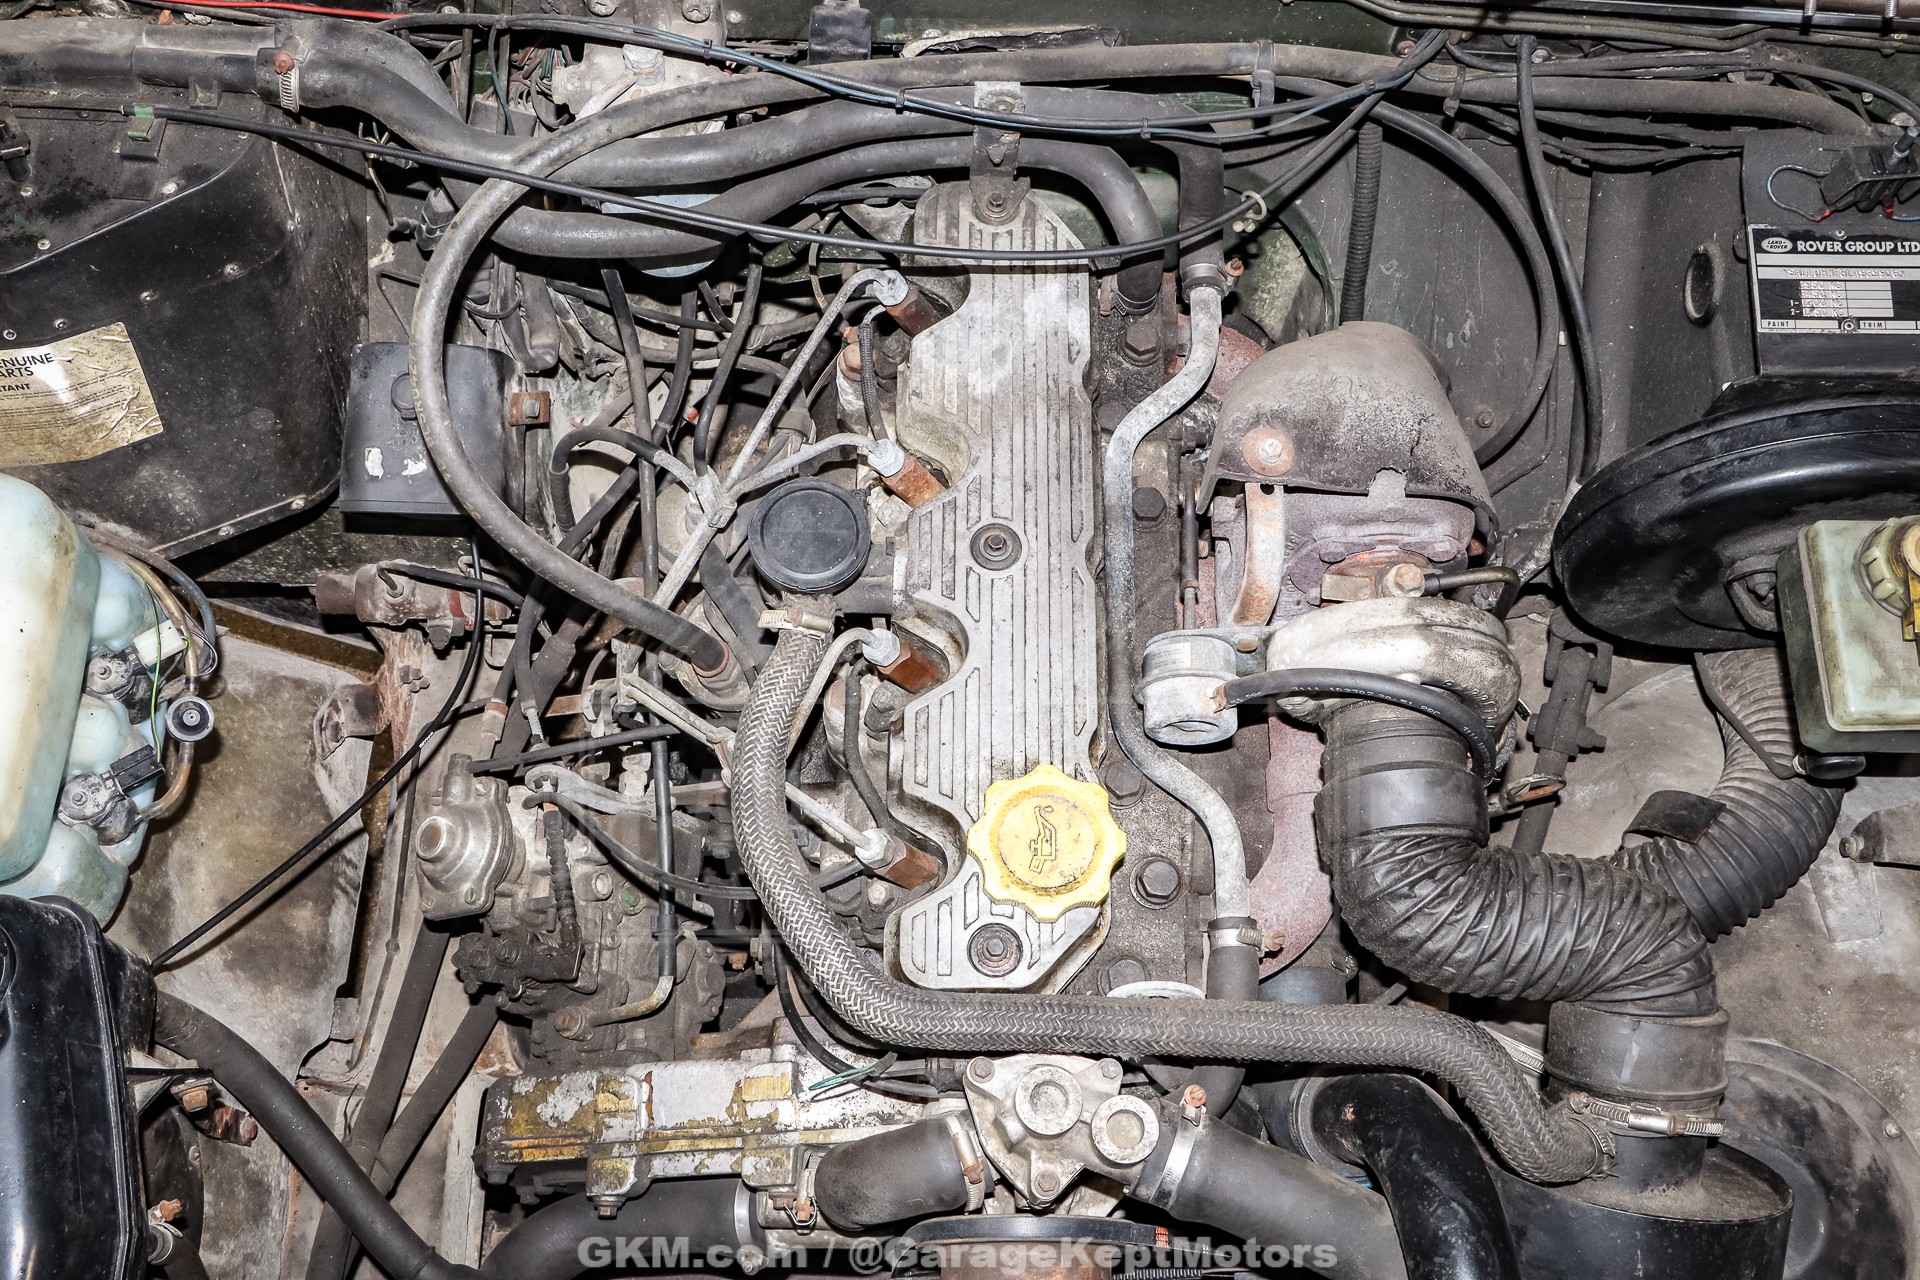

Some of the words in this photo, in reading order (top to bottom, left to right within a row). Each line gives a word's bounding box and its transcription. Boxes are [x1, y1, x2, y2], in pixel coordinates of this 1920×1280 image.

[1797, 241, 1842, 252] ROVER
[1845, 241, 1895, 253] GROUP
[1898, 242, 1920, 253] LTD
[0, 383, 30, 392] TANT
